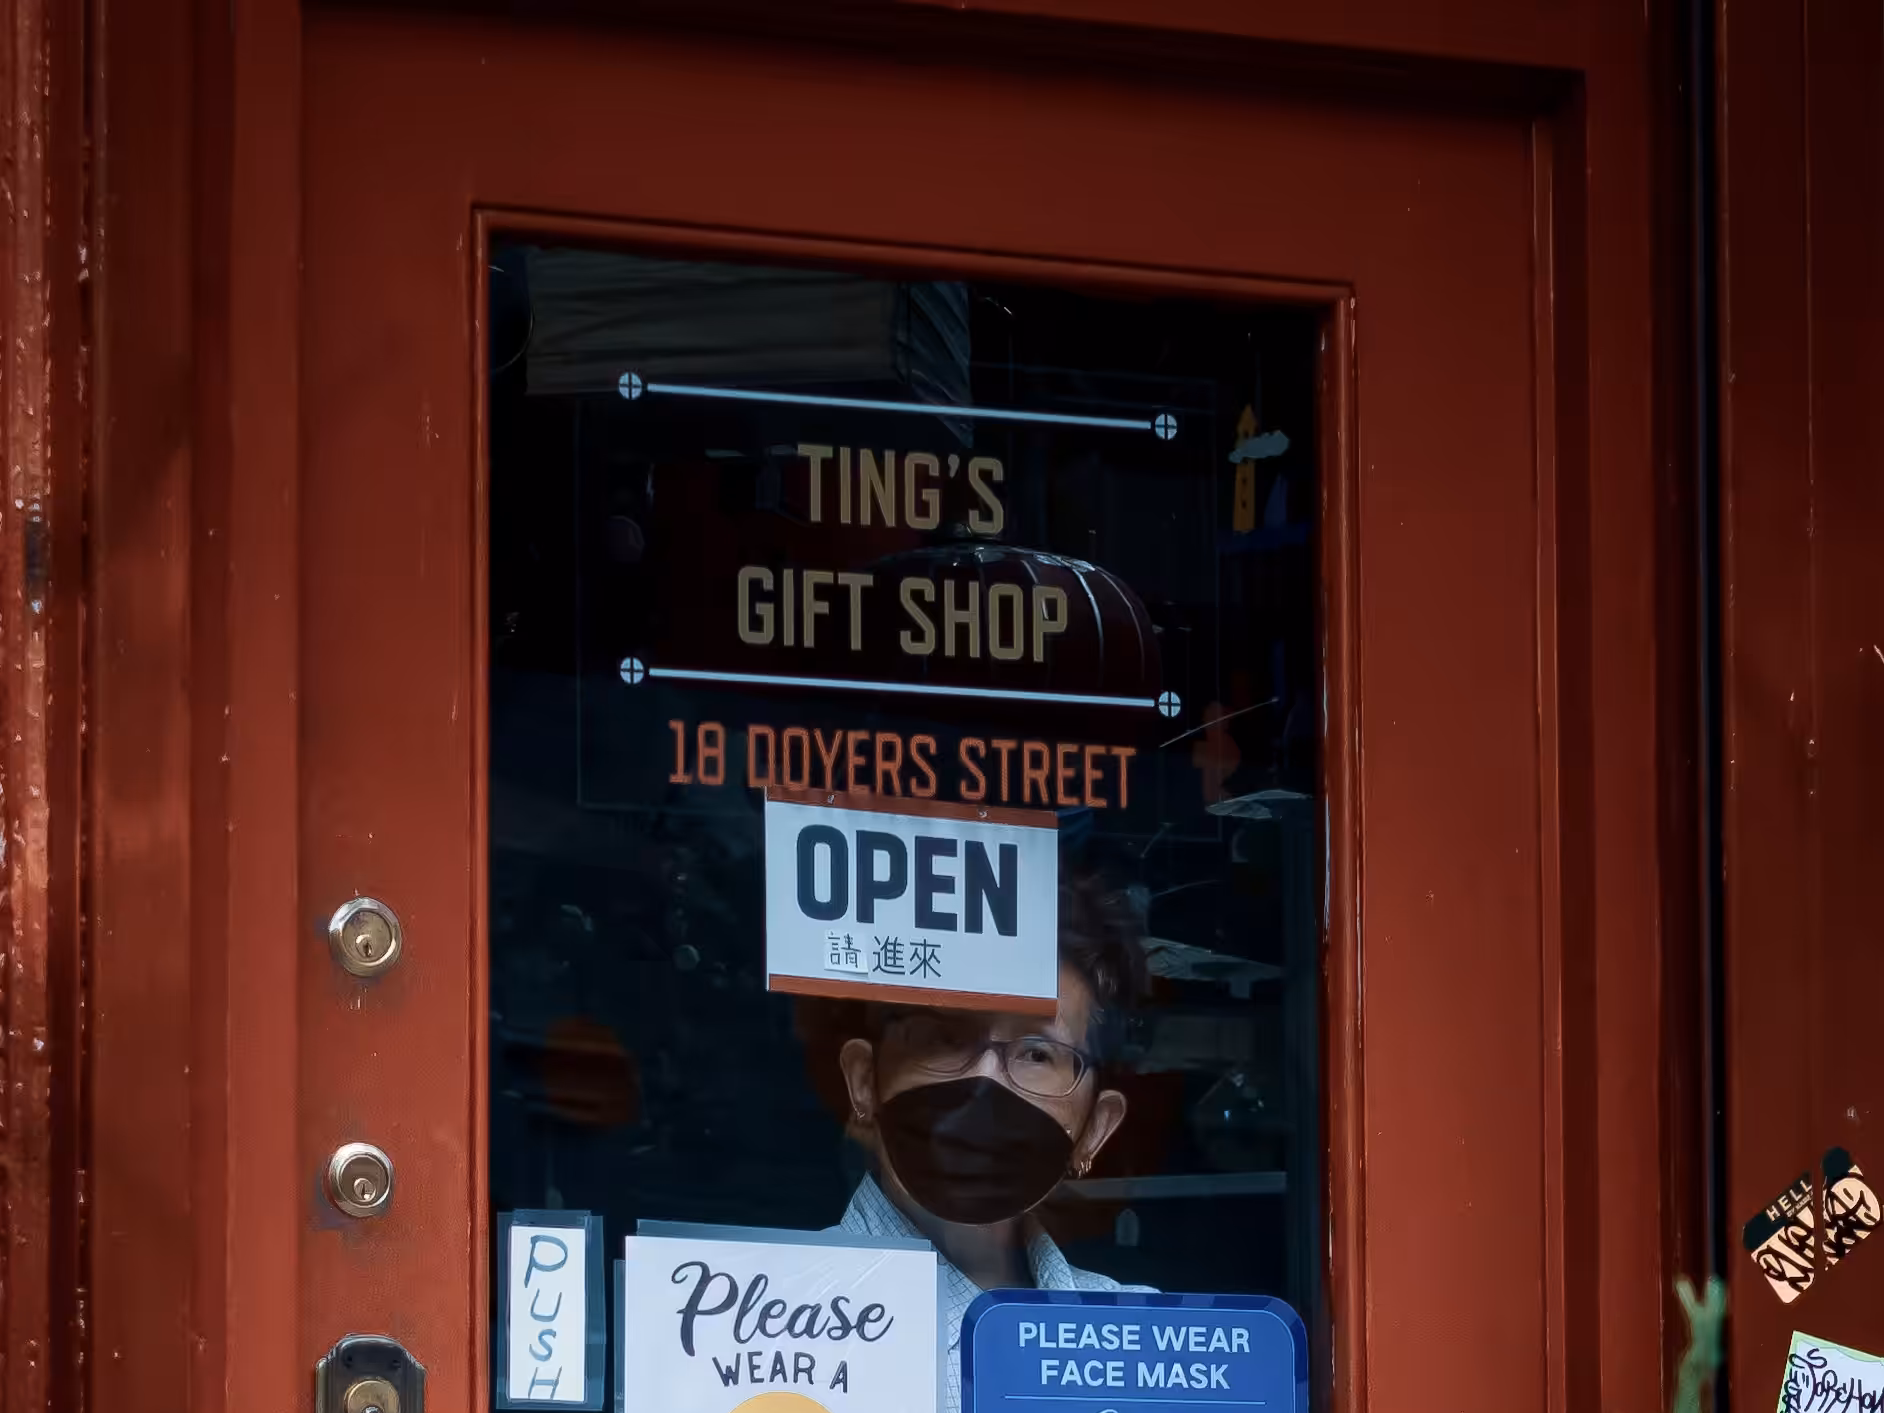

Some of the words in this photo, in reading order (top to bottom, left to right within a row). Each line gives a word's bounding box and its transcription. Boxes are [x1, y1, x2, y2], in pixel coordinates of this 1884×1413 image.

[798, 443, 1004, 534] TING'S
[737, 566, 873, 651] GIFT
[899, 576, 1068, 663] SHOP
[668, 719, 725, 786] 18
[747, 724, 937, 799] DOYERS
[959, 736, 1137, 809] STREET
[796, 824, 1018, 937] OPEN
[827, 931, 942, 979] 請進來
[524, 1234, 569, 1400] PUSH
[671, 1261, 894, 1356] Please
[1018, 1322, 1141, 1350] PLEASE
[1152, 1325, 1250, 1353] WEAR
[712, 1351, 816, 1387] WEAR
[829, 1360, 848, 1393] A
[1040, 1359, 1125, 1387] FACE
[1137, 1362, 1230, 1389] MASK
